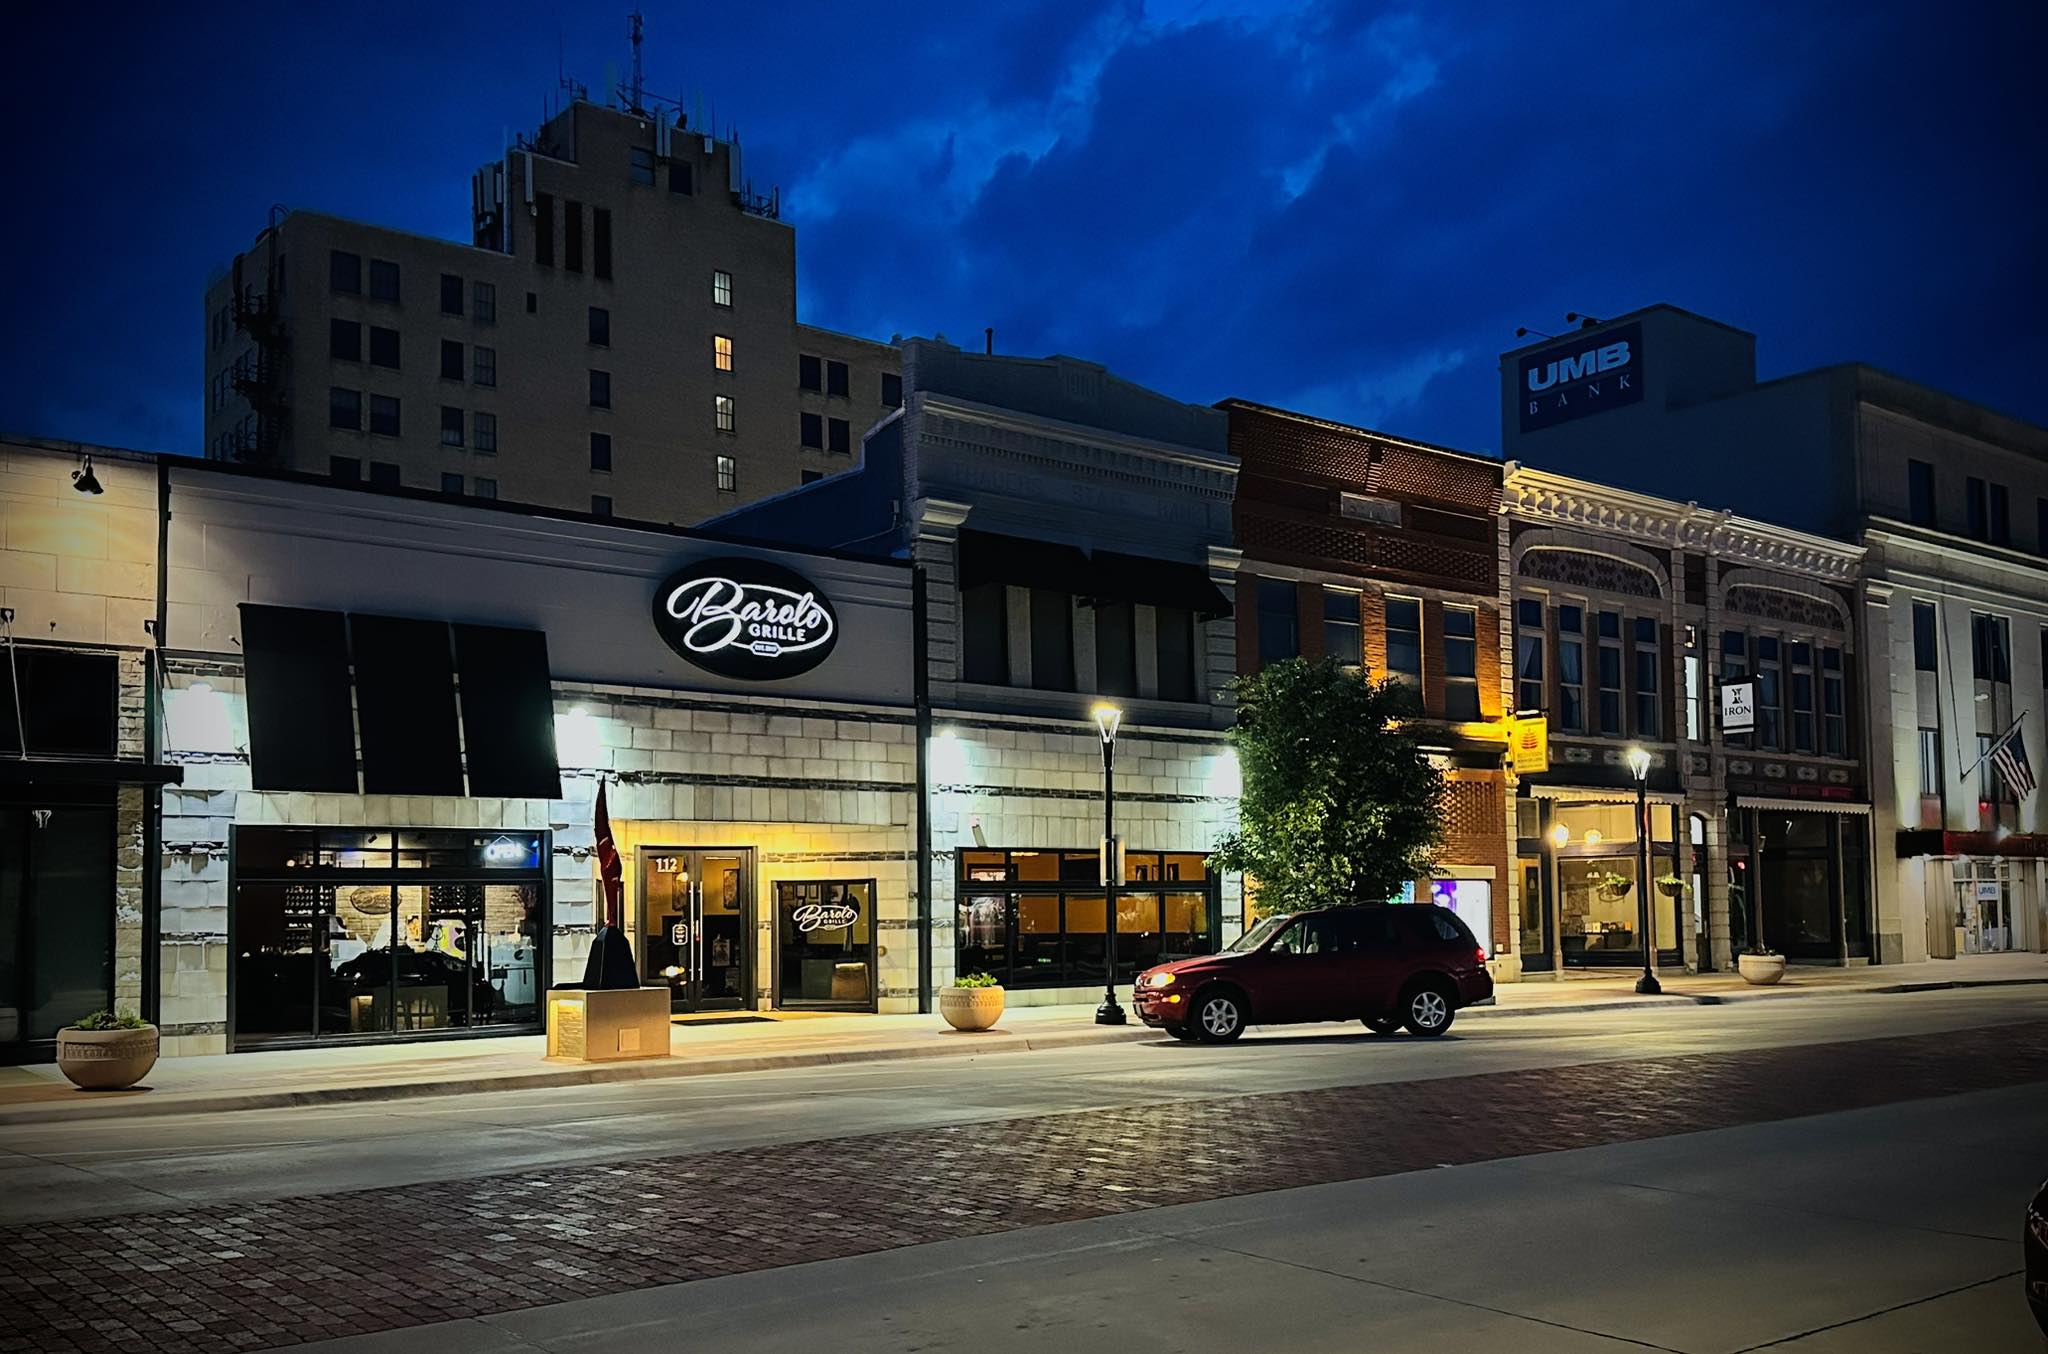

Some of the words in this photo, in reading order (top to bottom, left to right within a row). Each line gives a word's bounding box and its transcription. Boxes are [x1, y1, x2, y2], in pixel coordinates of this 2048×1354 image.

[1528, 341, 1631, 391] UMB
[1529, 374, 1631, 415] BANK
[667, 577, 825, 652] Barolo
[748, 624, 807, 642] GRILLE
[1724, 705, 1752, 716] IRON
[656, 858, 677, 873] 112
[793, 904, 853, 931] Barolo
